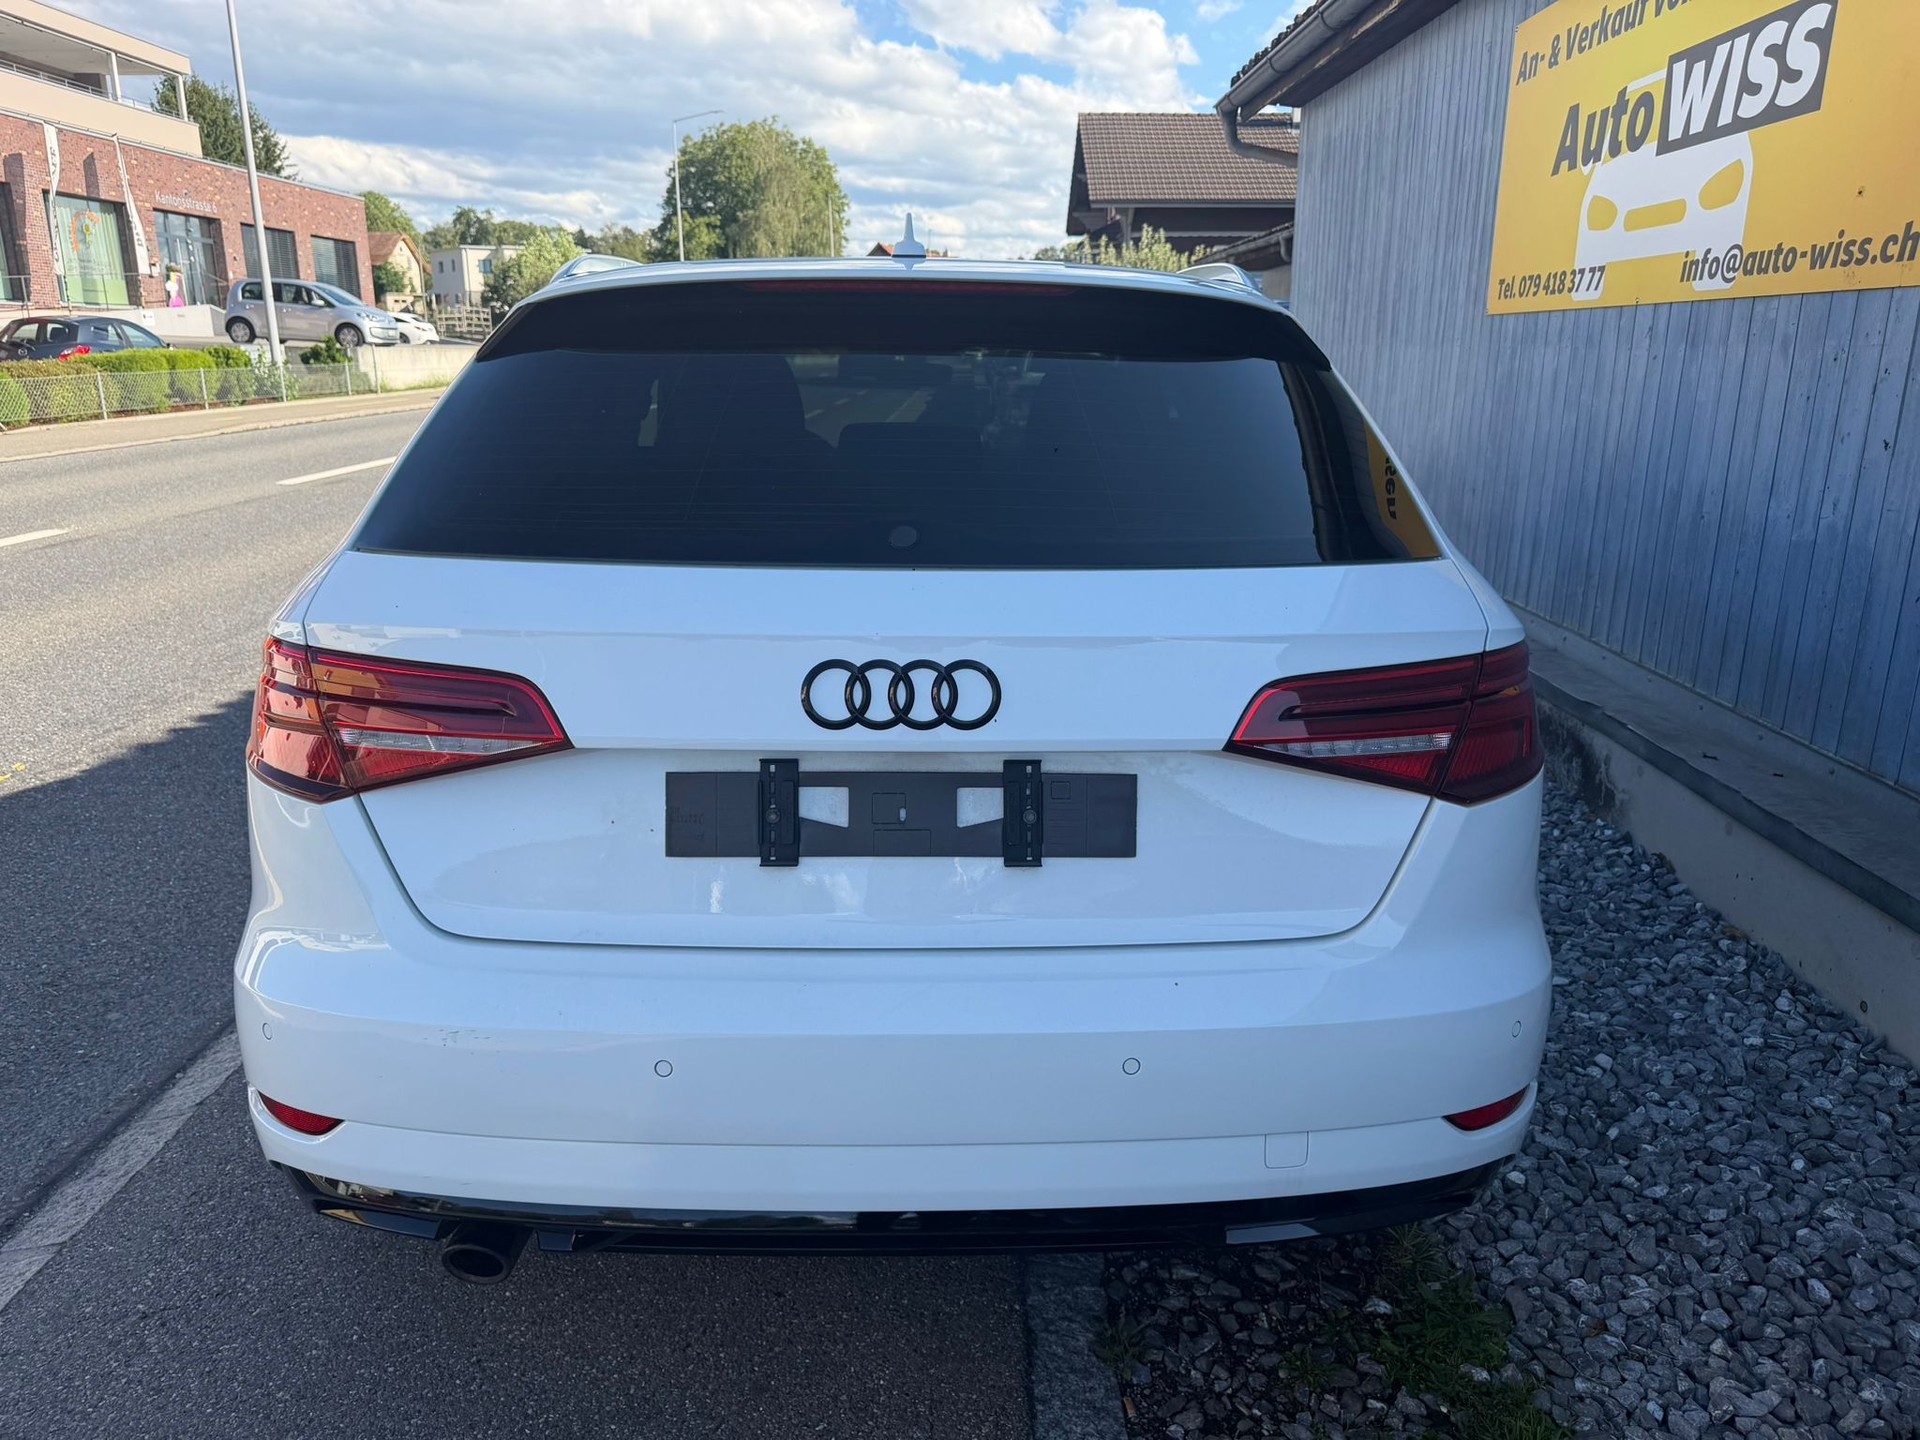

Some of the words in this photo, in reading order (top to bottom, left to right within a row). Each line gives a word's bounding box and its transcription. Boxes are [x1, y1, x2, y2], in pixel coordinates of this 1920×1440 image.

[1516, 51, 1546, 86] An-
[1548, 34, 1561, 70] &
[1566, 0, 1650, 61] Verkauf
[1551, 86, 1655, 177] Auto
[1498, 275, 1516, 300] Tel.
[1519, 273, 1541, 298] 079
[1543, 270, 1567, 295] 418
[1680, 221, 1920, 283] info@auto-wiss.ch
